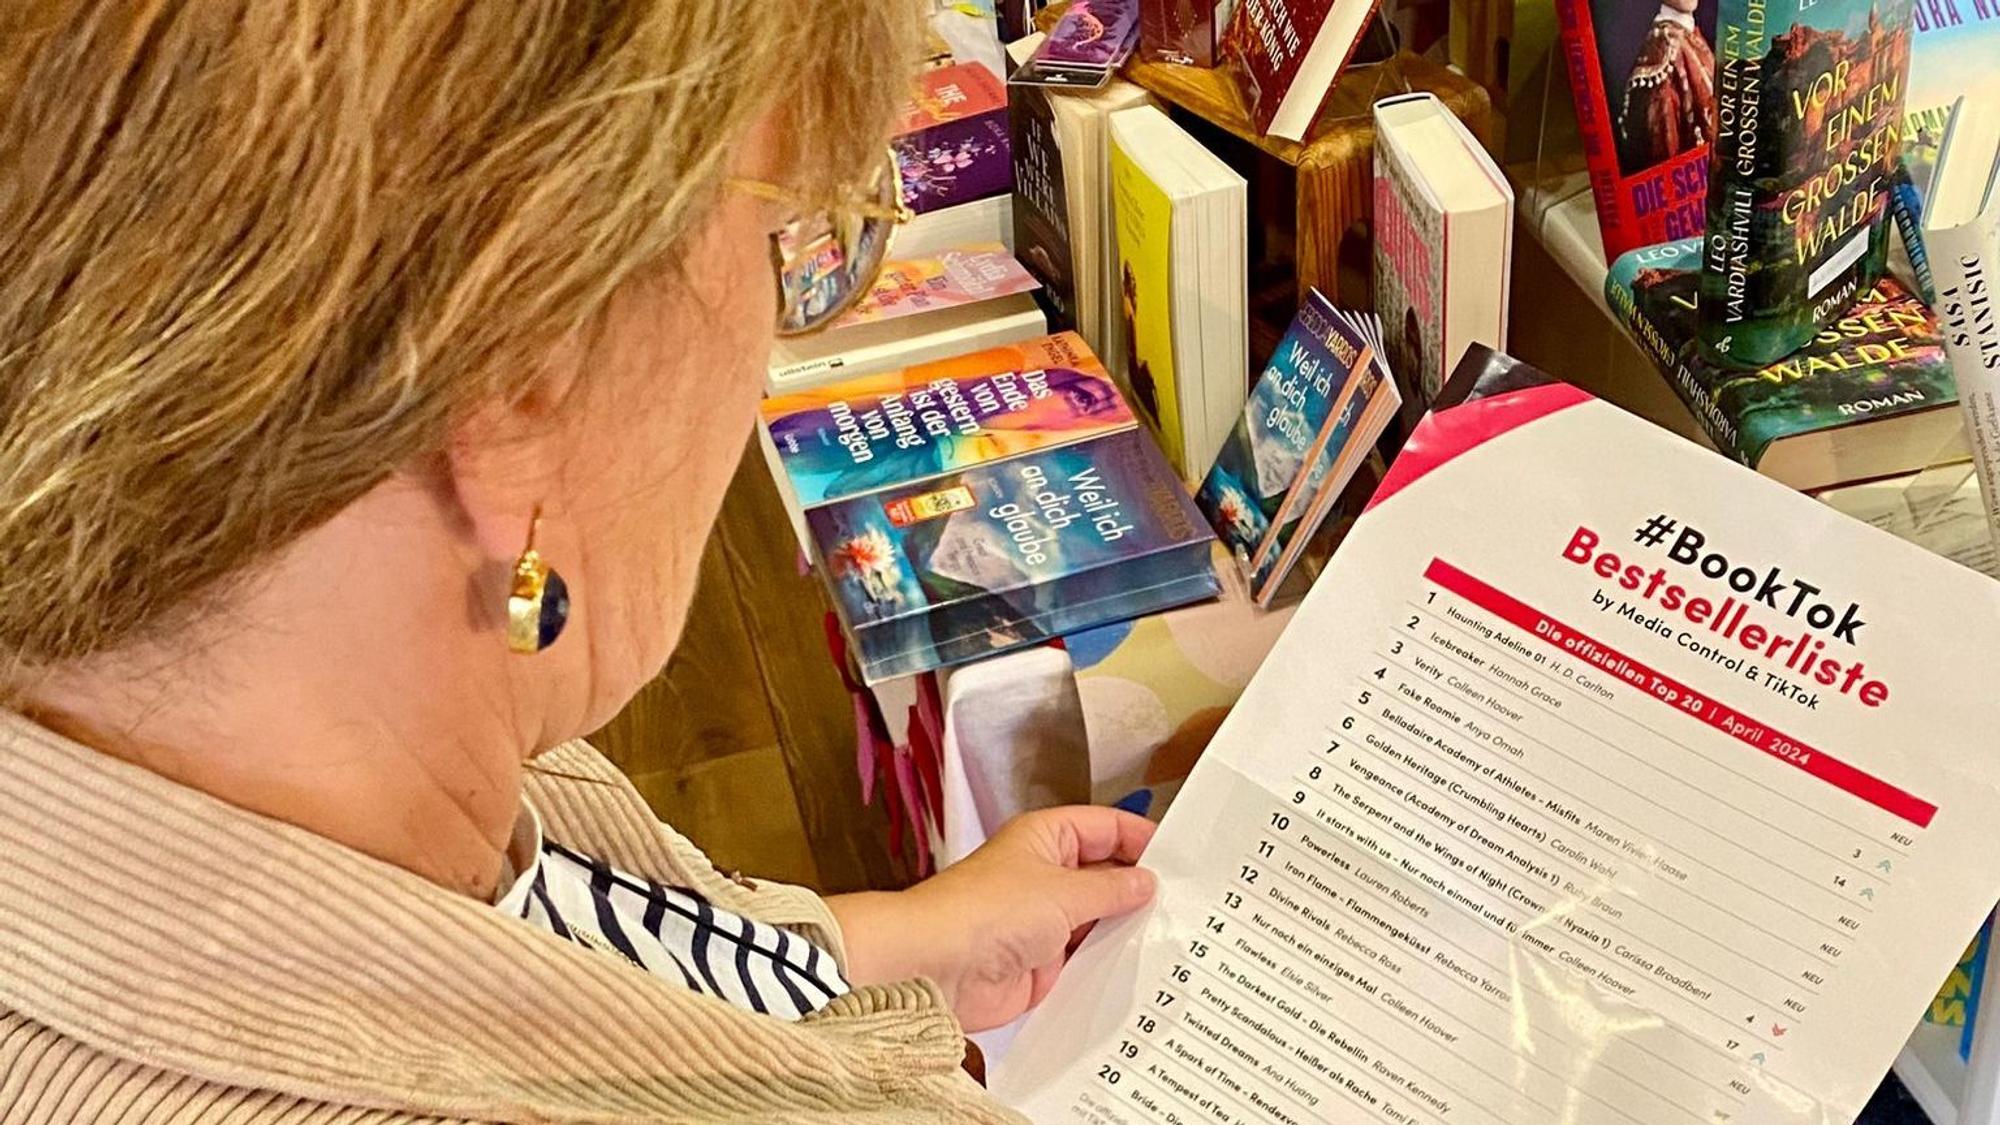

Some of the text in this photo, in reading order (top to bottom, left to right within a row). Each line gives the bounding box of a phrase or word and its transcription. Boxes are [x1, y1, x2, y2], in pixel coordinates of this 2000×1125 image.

[1260, 19, 1284, 70] KÖNIG
[1282, 18, 1300, 58] WIE
[1718, 24, 1741, 138] VOR EINEM
[1737, 0, 1767, 177] GROSSEN WALDE
[1792, 60, 1850, 120] VOR
[1826, 73, 1900, 152] EINEM
[1632, 174, 1668, 219] DIE
[1782, 127, 1901, 226] GROSSEN
[1795, 176, 1882, 266] WALDE
[1636, 245, 1680, 264] LEO
[1710, 190, 1753, 323] LEO VARDIASHVILI
[1812, 276, 1858, 325] ROMAN
[1289, 340, 1334, 399] Weil ich
[1325, 326, 1358, 370] YARROS
[1761, 337, 1912, 385] WALDE
[909, 390, 952, 438] ist der
[928, 376, 981, 436] gestern
[970, 382, 1001, 414] von
[990, 371, 1029, 412] Ende
[1022, 369, 1054, 400] Das
[1267, 366, 1309, 413] an dich
[1838, 388, 1926, 416] ROMAN
[828, 399, 874, 465] morgen
[860, 408, 890, 441] von
[878, 393, 926, 450] Anfang
[1266, 404, 1307, 451] glaube
[1020, 465, 1082, 530] an dich
[1067, 467, 1119, 513] Weil
[989, 502, 1053, 565] glaube
[1091, 511, 1135, 542] ich
[1633, 513, 1871, 647] #BookTok
[1427, 591, 1615, 701] 1 Haunting Adeline Carlton
[1562, 526, 1890, 709] Bestsellerliste
[1390, 640, 1524, 722] 3 Verity Colleen Hoover
[1406, 615, 1562, 709] 2 Icebreaker Hannah Grace
[1592, 588, 1821, 712] by Media Control TikTok
[1374, 667, 1525, 759] 4 Fake Roomie Anya Omah
[1535, 619, 1811, 765] Die offiziellen Top 20 April 2024
[1342, 716, 1588, 865] 6 Golden Heritage (Crumbling Hearts) Carolin
[1358, 690, 1621, 846] 5 Belladaire Academy Athletes Misfits Maren
[1326, 740, 1548, 879] 7 Vengeance (Academy Dream Analysis
[1890, 832, 1913, 847] NEU
[1271, 812, 1429, 918] 10 Powerless Lauren Roberts
[1292, 790, 1636, 995] 9 starts with Nur noch einmal und immer Colleen Hoover
[1308, 766, 1712, 1000] 8 The Serpent Wings Night Nyaxia Carissa Broadbent
[1240, 865, 1402, 974] 12 Divine Rivals Rebecca Ross
[1258, 840, 1479, 984] 11 Iron Flame Flammengeküsst Rebecca
[1837, 915, 1860, 930] NEU
[1206, 916, 1333, 1003] 14 Flawless Elsie Silver
[1224, 891, 1458, 1043] 13 Nur noch ein einziges Mal Colleen Hoover
[1801, 970, 1824, 985] NEU
[1819, 943, 1842, 957] NEU
[1137, 1015, 1156, 1034] 18
[1189, 940, 1451, 1114] 15 The Darkest Gold Die Rebellin Raven Kennedy
[1783, 998, 1806, 1013] NEU
[1097, 1064, 1121, 1085] 20
[1119, 1040, 1139, 1059] 19
[1155, 990, 1319, 1107] 17 Twisted Dreams Ana Huang
[1171, 965, 1407, 1123] 16 Pretty Scandalous Heißer Rache Tami
